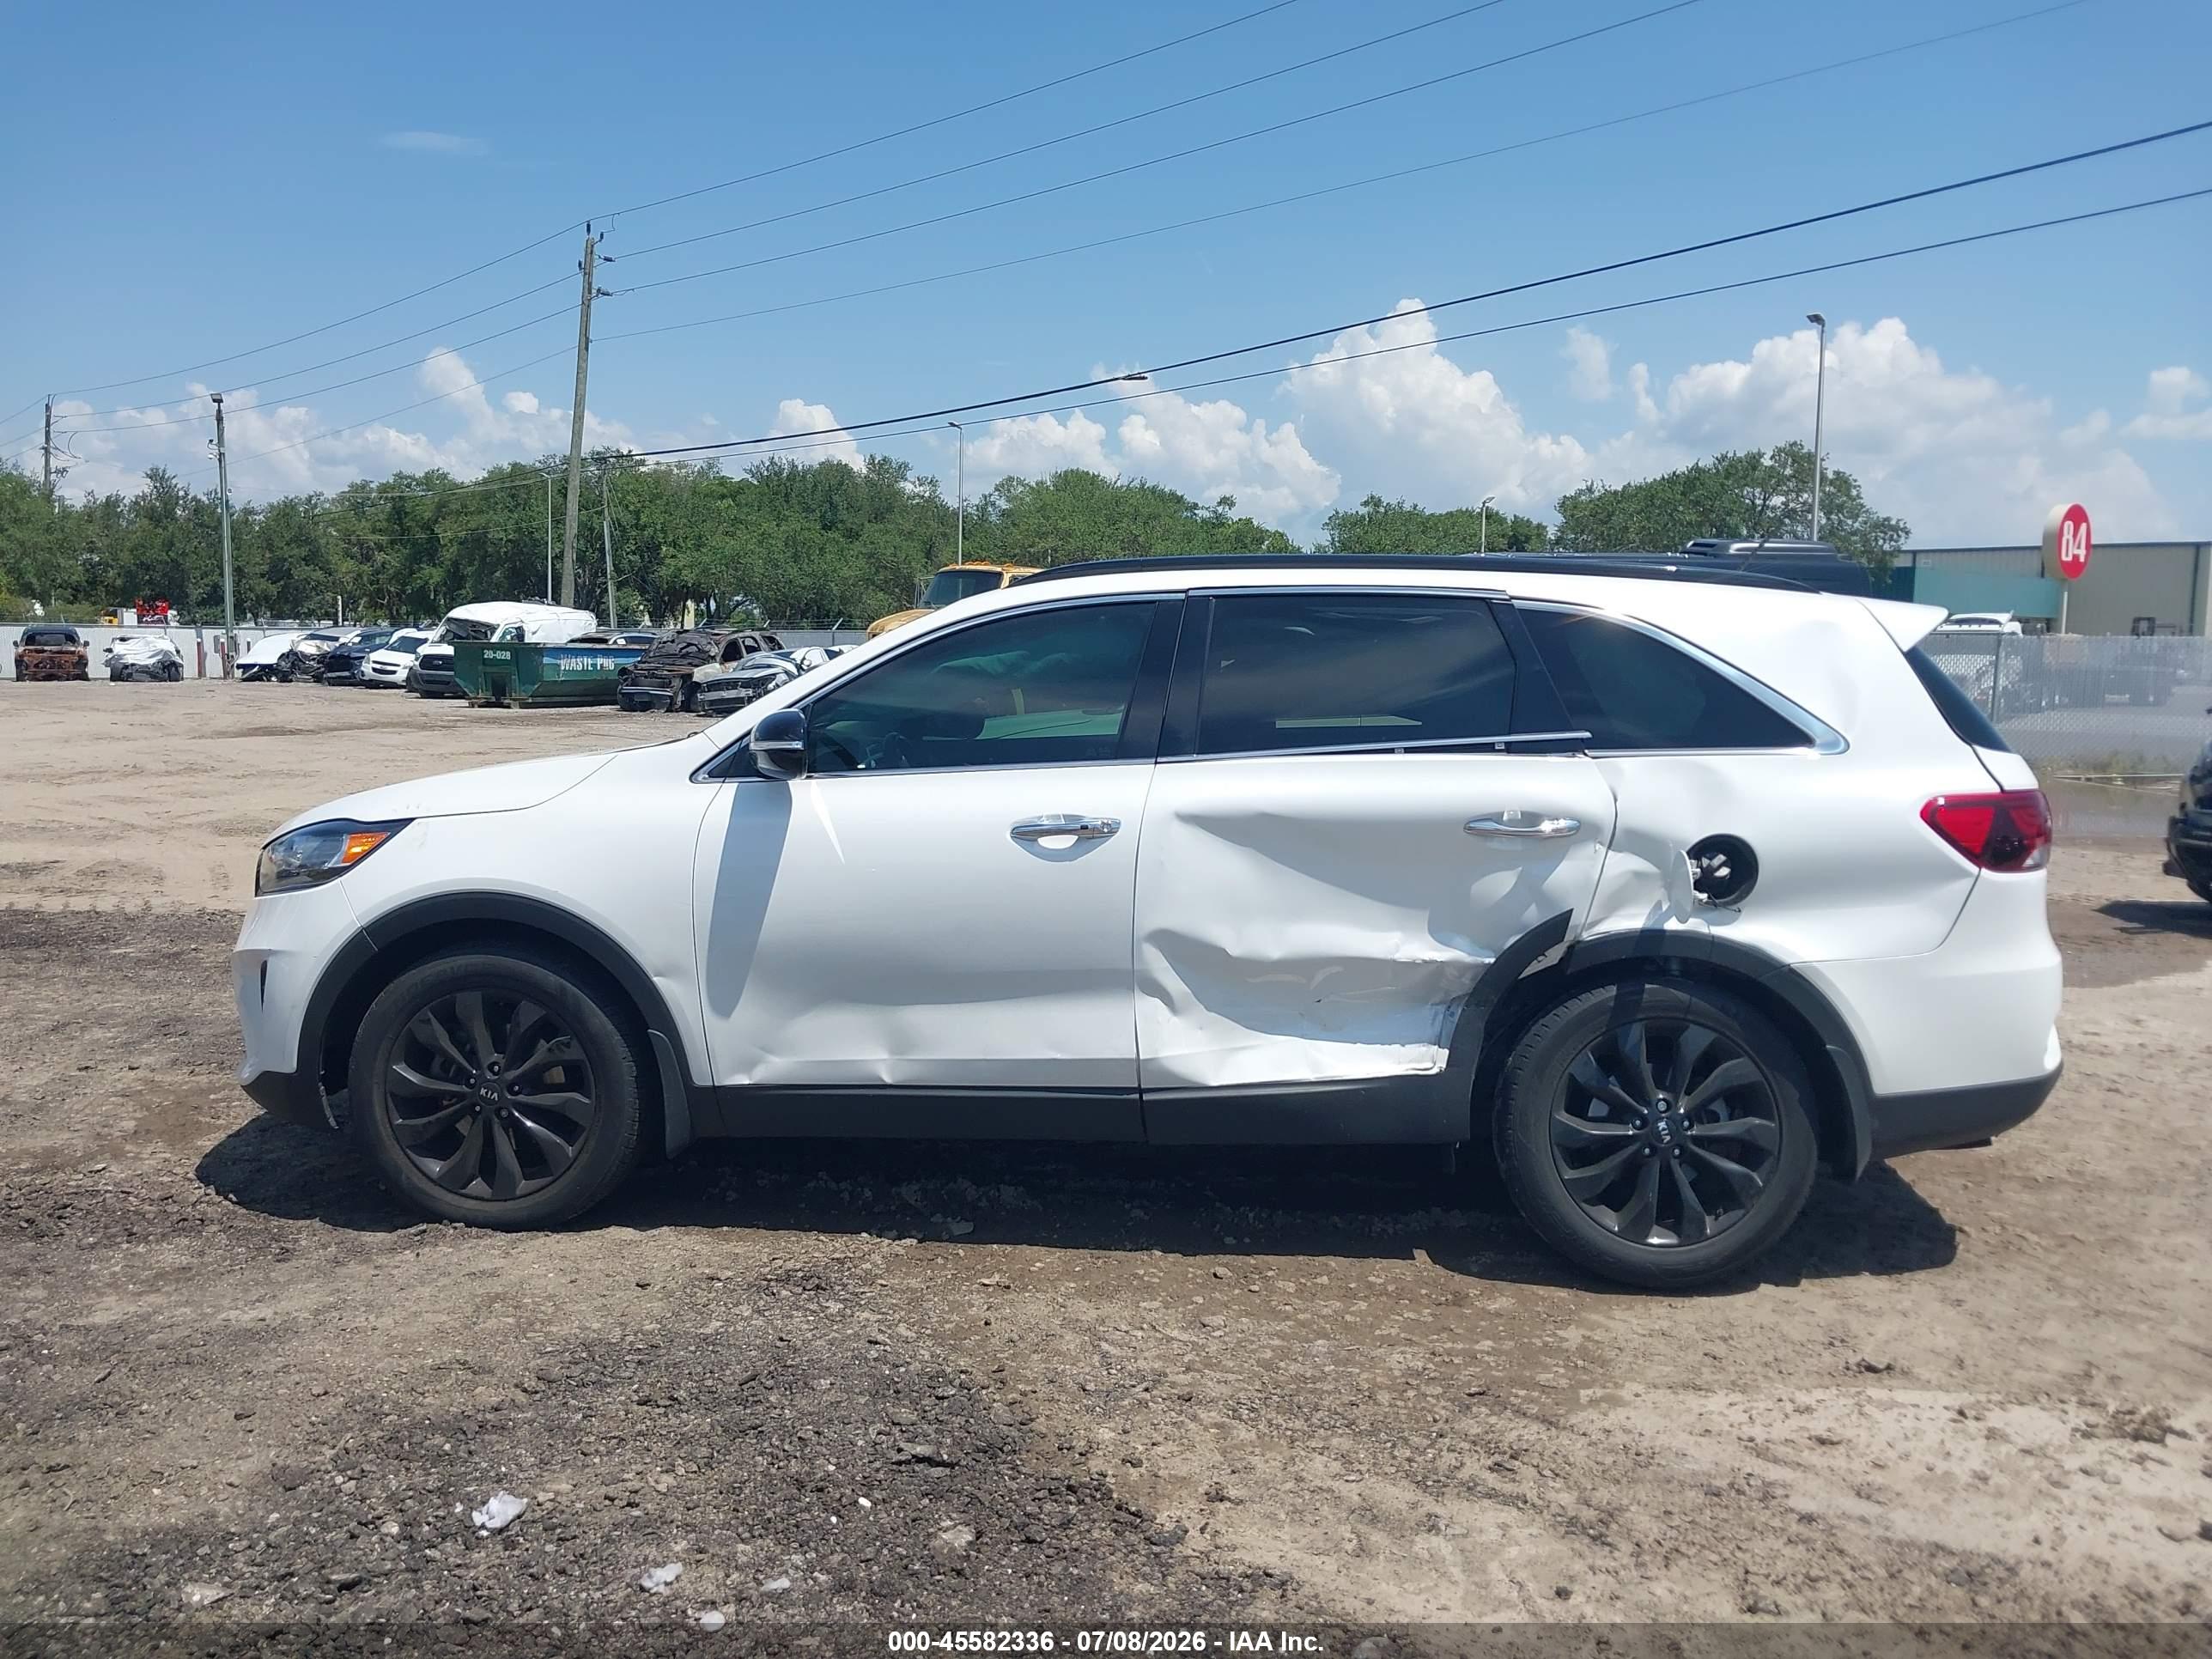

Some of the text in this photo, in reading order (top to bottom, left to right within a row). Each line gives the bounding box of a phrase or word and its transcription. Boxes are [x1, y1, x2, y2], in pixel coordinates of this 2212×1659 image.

[2061, 520, 2087, 562] 84
[483, 649, 511, 660] 20-028
[561, 653, 593, 671] WASTE
[479, 1087, 499, 1101] KIA
[1657, 1121, 1671, 1144] KIA
